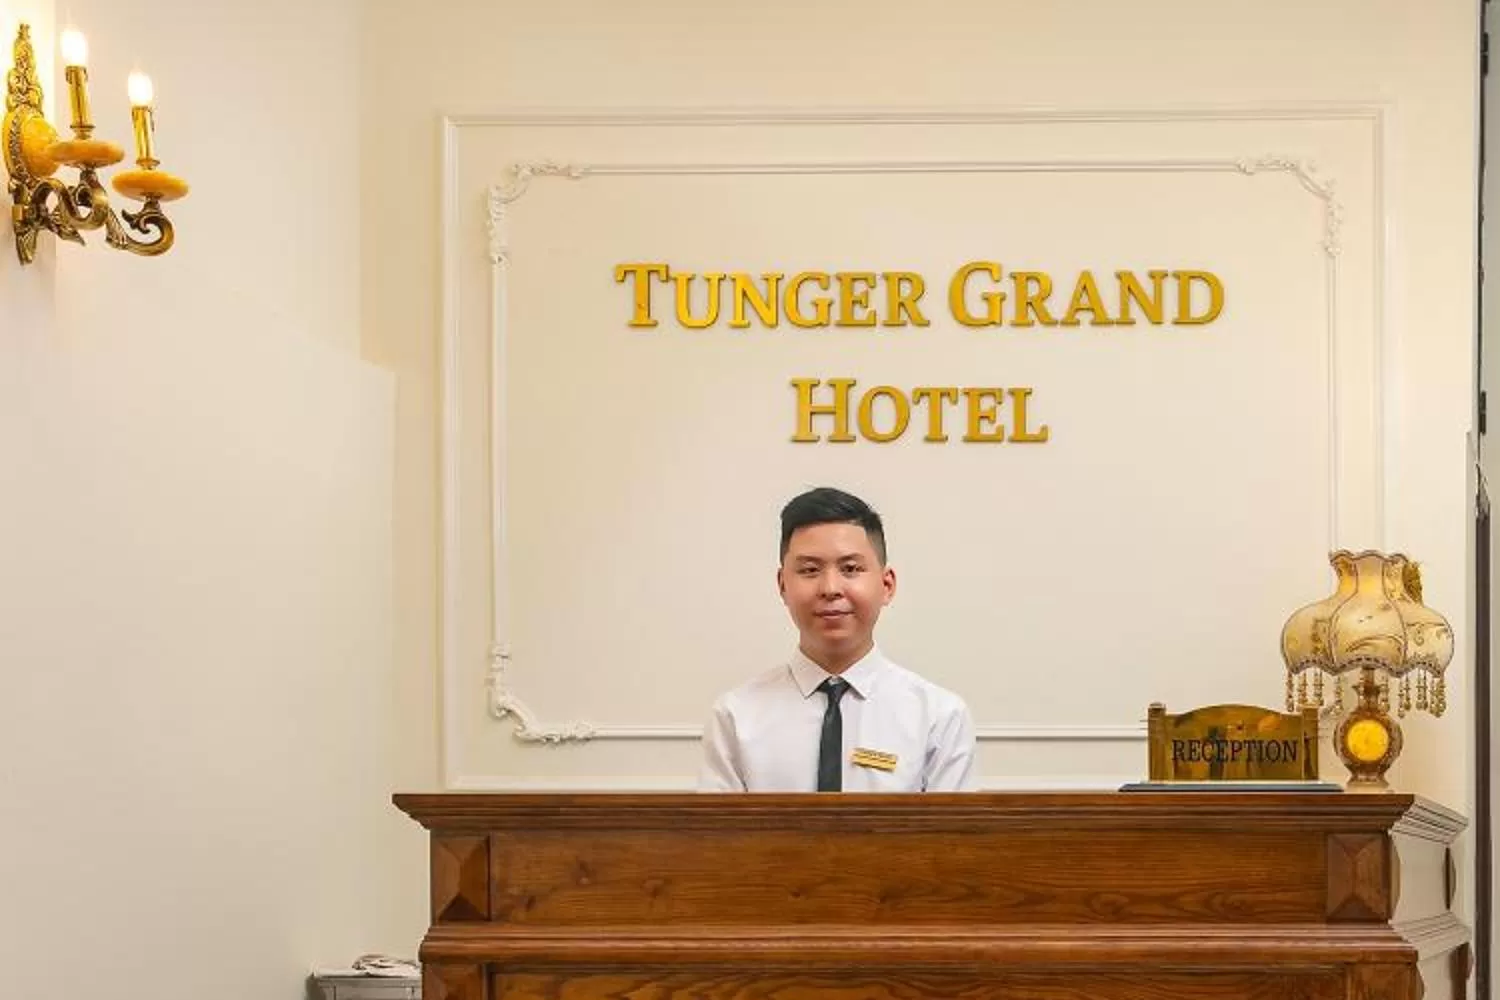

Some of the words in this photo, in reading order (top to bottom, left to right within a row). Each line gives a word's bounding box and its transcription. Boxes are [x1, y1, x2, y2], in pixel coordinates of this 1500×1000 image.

[614, 262, 930, 328] TUNGER
[947, 261, 1226, 327] GRAND
[789, 377, 1050, 444] HOTEL
[1171, 738, 1298, 764] RECEPTION
